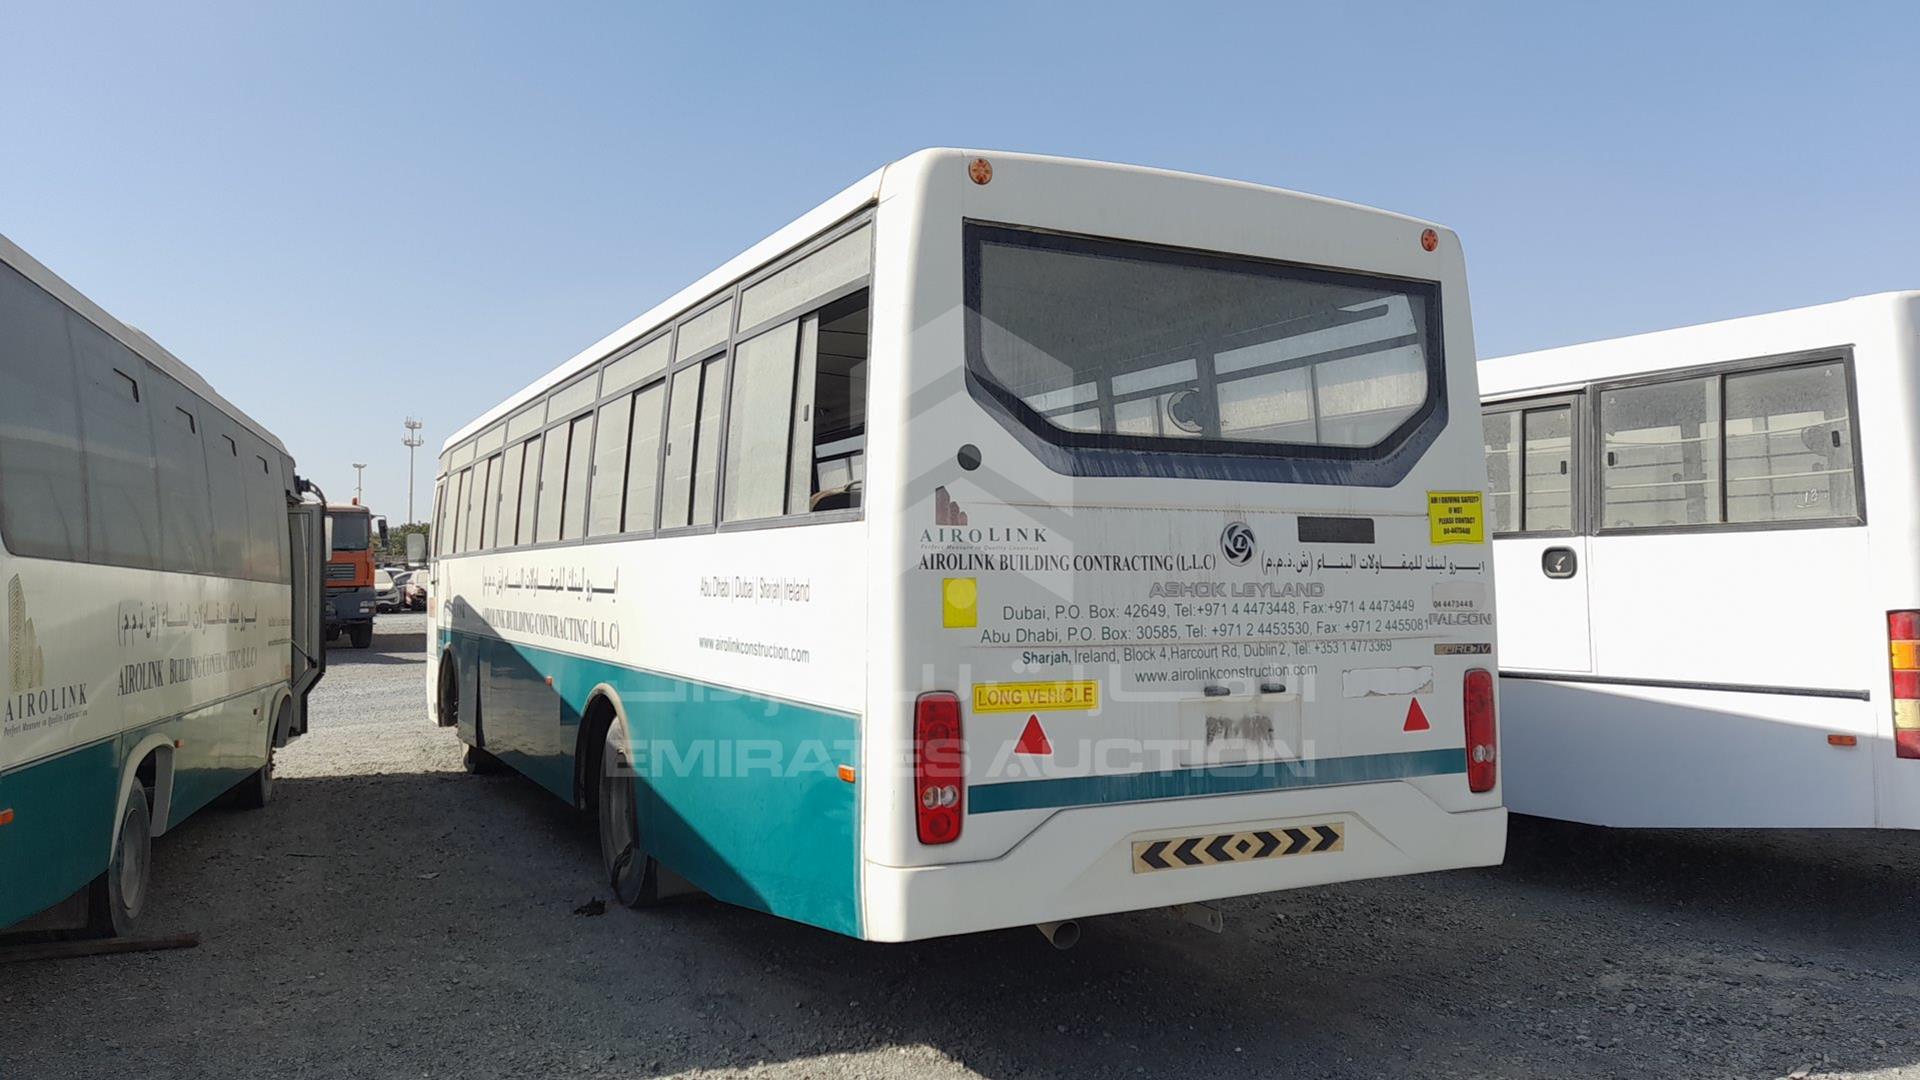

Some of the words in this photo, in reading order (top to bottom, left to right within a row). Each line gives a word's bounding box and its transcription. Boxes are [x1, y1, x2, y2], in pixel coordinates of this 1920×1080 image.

[919, 527, 1048, 544] AIROLINK
[918, 552, 996, 571] AIROLINK
[999, 553, 1070, 572] BUILDING
[1073, 554, 1174, 572] CONTRACTING
[1176, 553, 1217, 573] (L.L.C)
[784, 576, 810, 602] Ireland
[1149, 581, 1227, 599] ASHOK
[1230, 582, 1326, 598] LEYLAND
[1002, 605, 1051, 622] Dubai,
[1055, 604, 1084, 620] P.O.
[1089, 603, 1120, 620] Box:
[1123, 603, 1170, 620] 42649,
[1231, 601, 1239, 615] 4
[1242, 601, 1299, 616] 4473448,
[1358, 600, 1366, 612] 4
[1368, 599, 1416, 612] 4473449
[1428, 612, 1493, 626] FALCON
[535, 612, 589, 645] CONTRACTING
[590, 616, 620, 652] (L.L.C)
[980, 628, 1011, 644] Abu
[1015, 627, 1062, 644] Dhabi,
[1067, 626, 1096, 642] P.O.
[1101, 625, 1132, 641] Box:
[1136, 624, 1182, 640] 30585,
[1185, 623, 1208, 639] Tel:
[1212, 623, 1242, 638] +971
[1246, 623, 1254, 637] 2
[1257, 621, 1313, 637] 4453530,
[1316, 620, 1340, 635] Fax:
[1344, 620, 1372, 634] +971
[1375, 620, 1382, 632] 2
[1384, 619, 1429, 632] 4455081
[1022, 650, 1072, 666] Sharjah,
[1074, 649, 1120, 664] Ireland,
[1124, 647, 1156, 662] Block
[1221, 644, 1240, 660] Rd,
[1314, 641, 1338, 654] +353
[117, 659, 164, 697] AIROLINK
[1134, 663, 1318, 683] www.airolinkconstruction.com
[4, 682, 88, 723] AIROLINK
[977, 689, 1023, 707] LONG
[1027, 687, 1093, 705] VEHICLE
